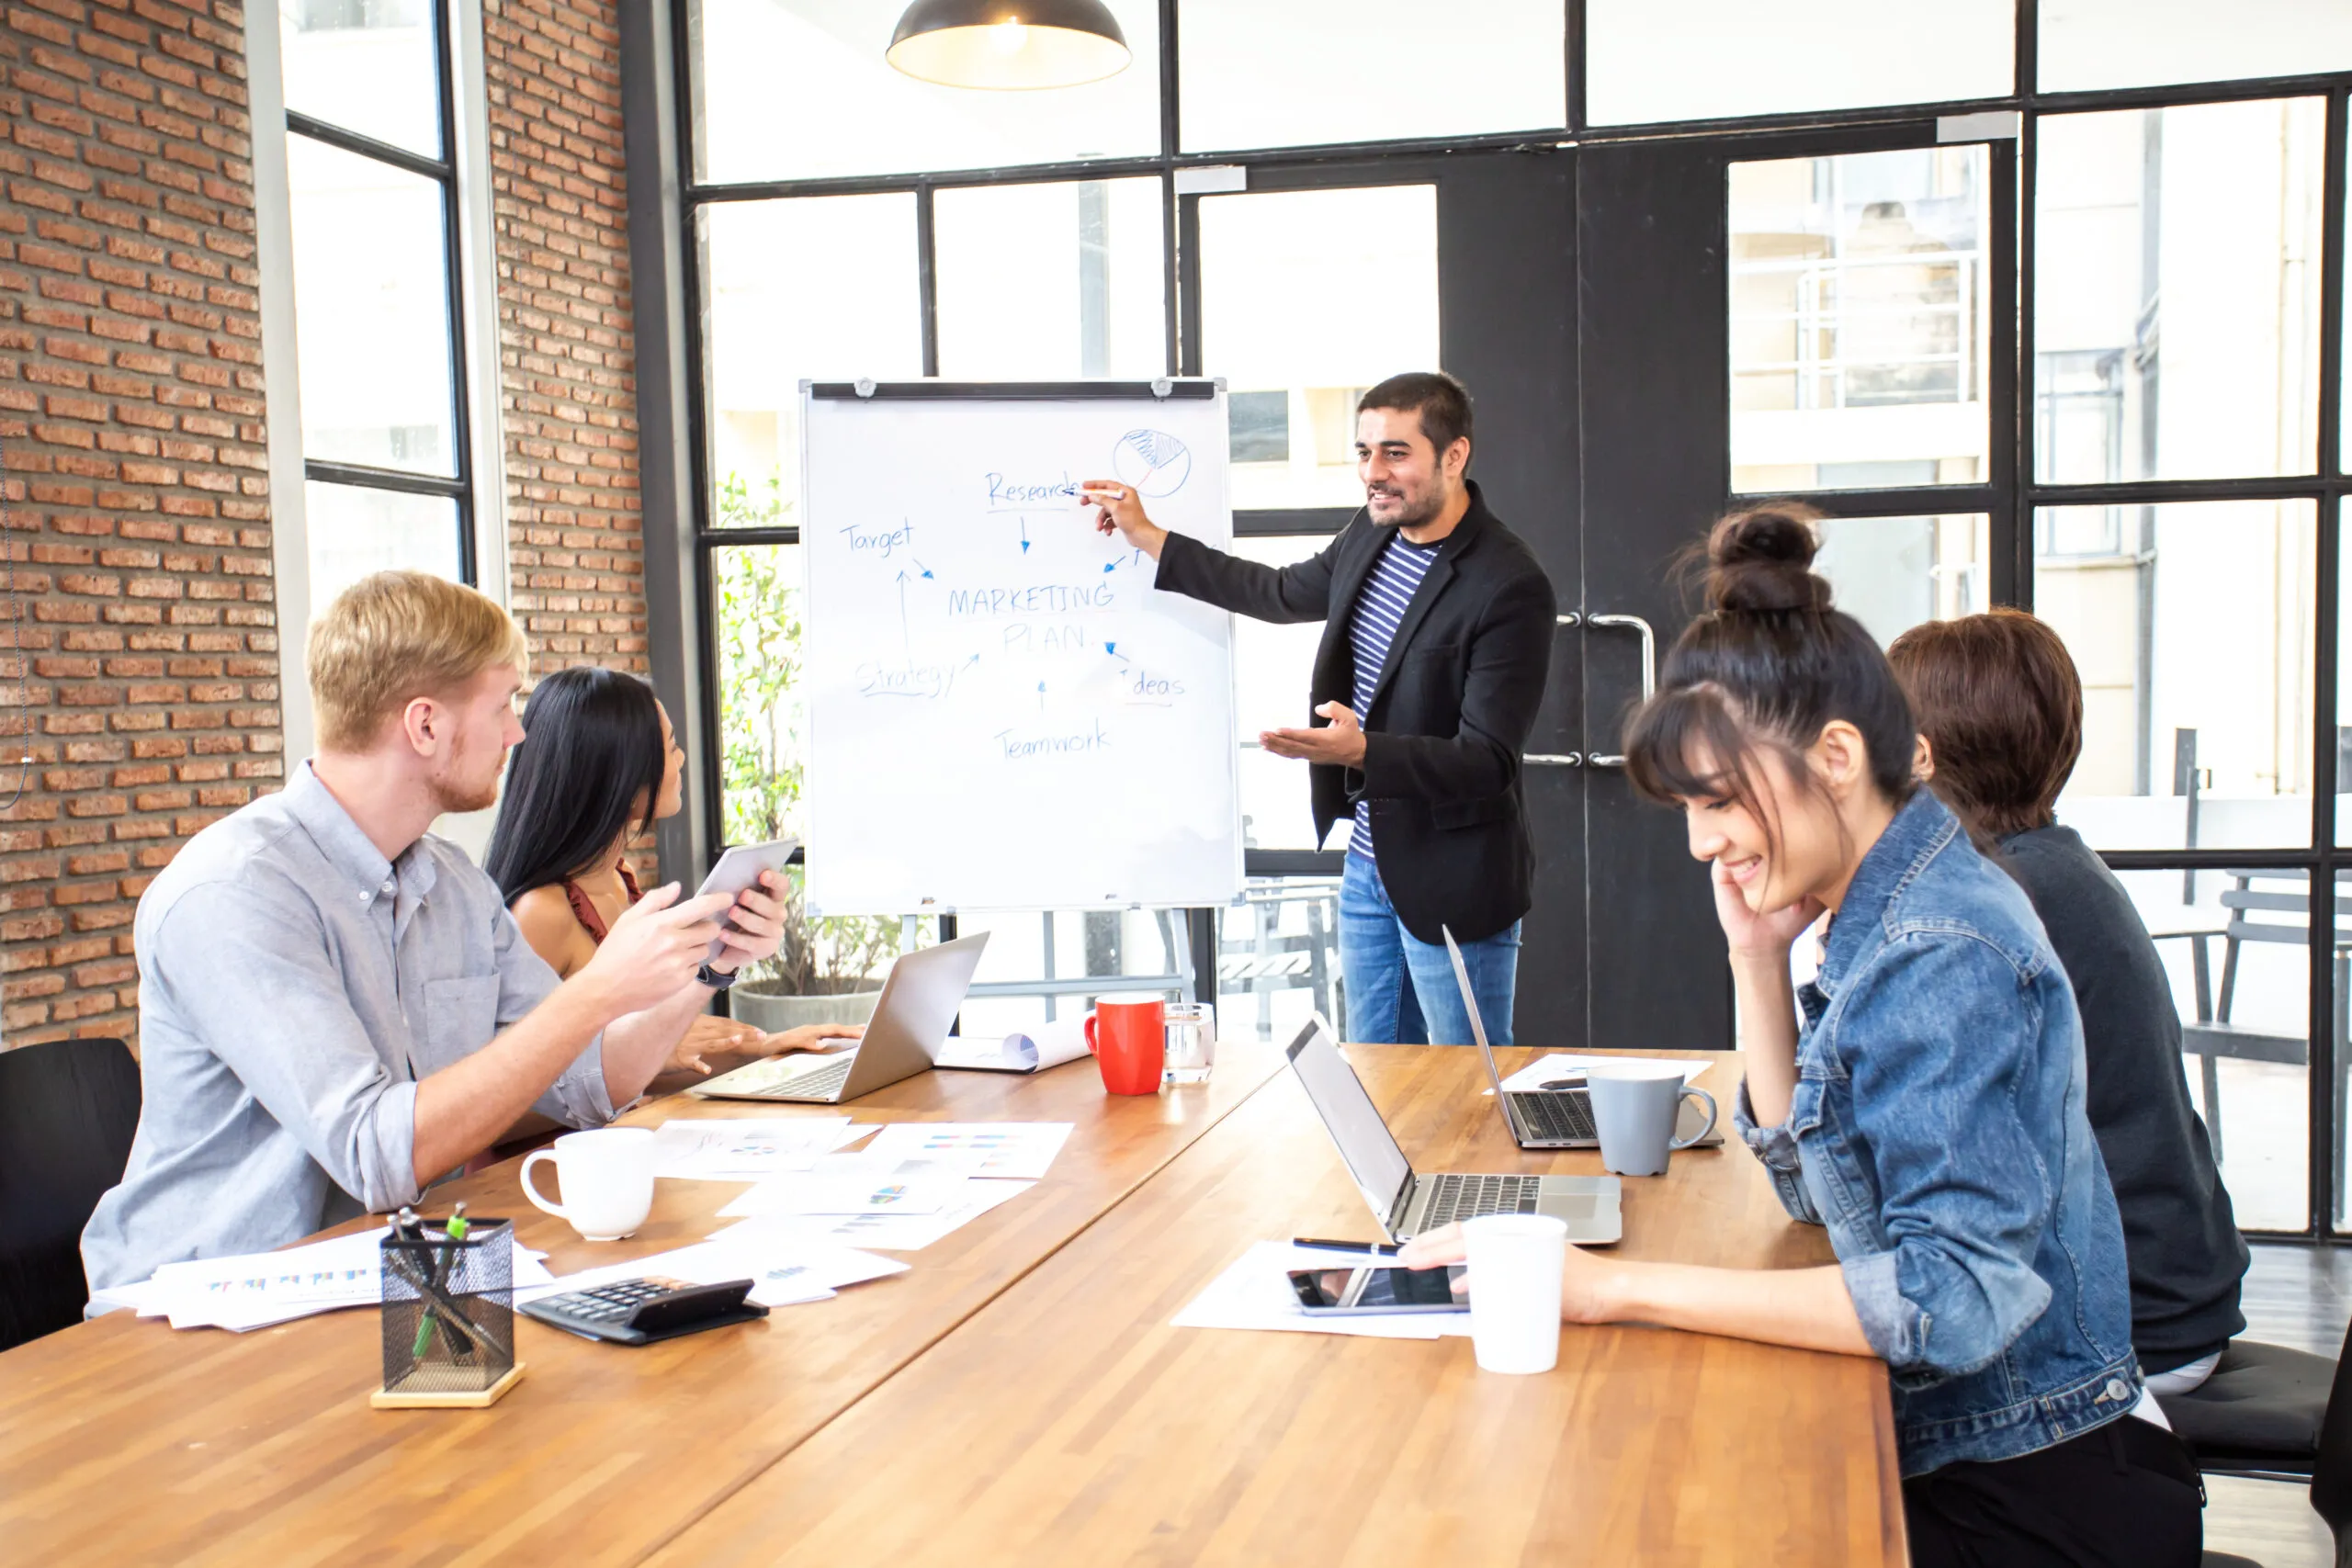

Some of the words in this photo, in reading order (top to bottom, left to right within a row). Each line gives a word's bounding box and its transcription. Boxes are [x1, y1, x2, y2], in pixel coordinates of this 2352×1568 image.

[838, 515, 915, 558] Target
[948, 580, 1115, 617] MARKETING
[854, 657, 956, 698] Strategy
[992, 716, 1113, 761] Teamwork
